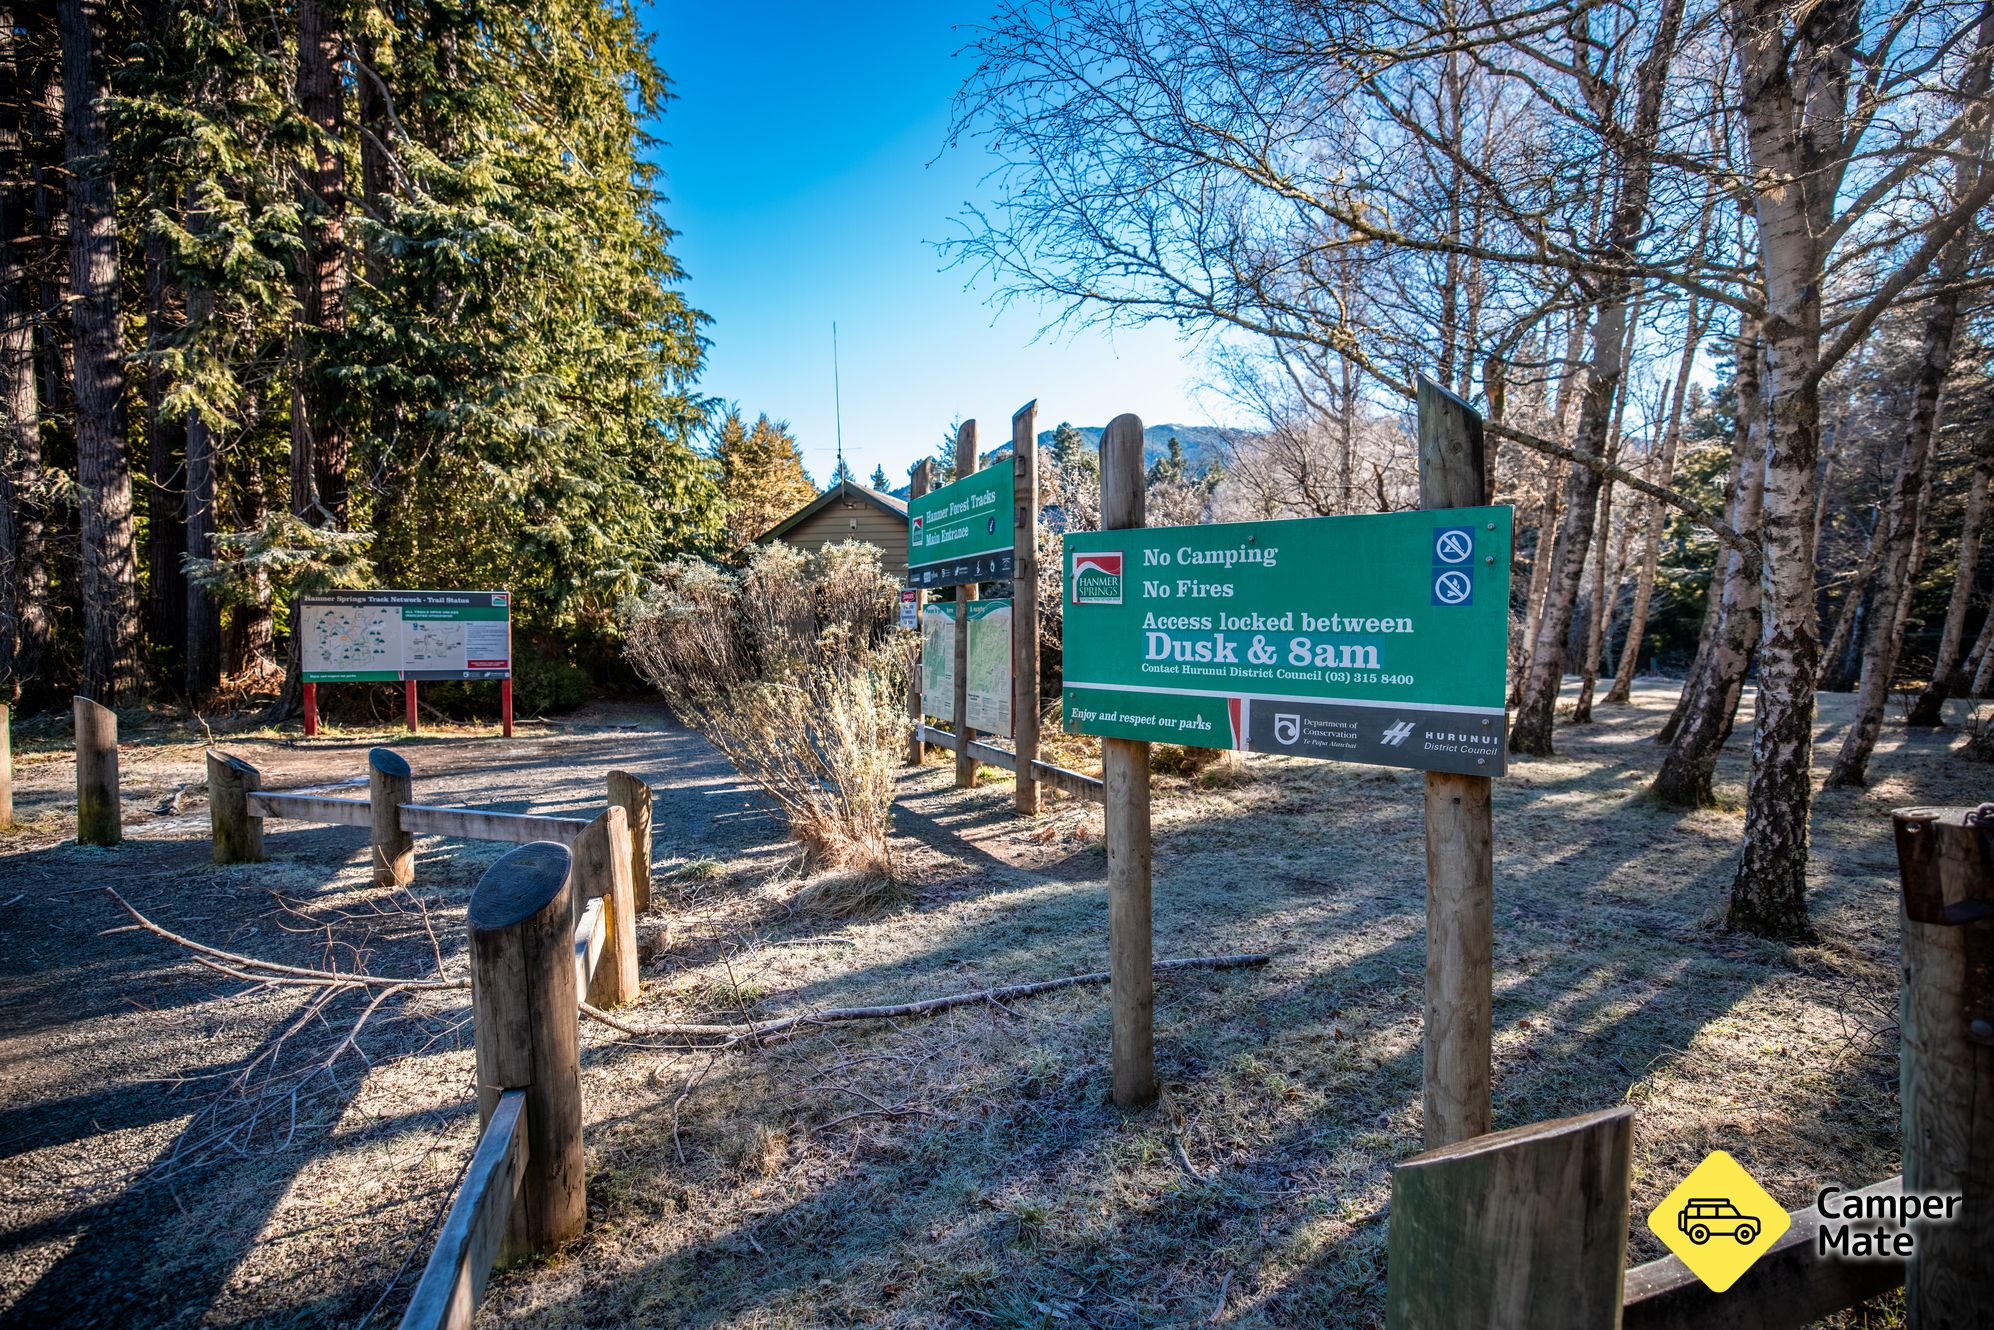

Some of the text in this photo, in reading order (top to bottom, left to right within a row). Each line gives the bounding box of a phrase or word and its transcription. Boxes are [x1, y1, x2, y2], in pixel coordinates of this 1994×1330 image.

[926, 490, 996, 524] Hanmer Forest Tracks
[926, 532, 941, 547] Main
[941, 525, 969, 543] Entrance
[1143, 544, 1279, 568] No Camping
[1080, 577, 1118, 587] HANMER
[1143, 579, 1235, 598] No Fires
[1079, 586, 1118, 597] SPRINGS
[336, 596, 366, 604] Springs
[1142, 611, 1414, 633] Access locked between
[1145, 631, 1381, 669] Dusk & 8am
[1141, 663, 1414, 685] Contact Hurunui District Council (03) 315 8400
[1071, 707, 1212, 731] Enjoy and respect our parks
[1303, 718, 1347, 729] Department
[1303, 728, 1358, 739] Conservation
[1425, 731, 1498, 745] HURUNUI
[1311, 739, 1328, 747] Papa
[1329, 741, 1357, 749] Atawhai
[1424, 742, 1498, 756] District Council
